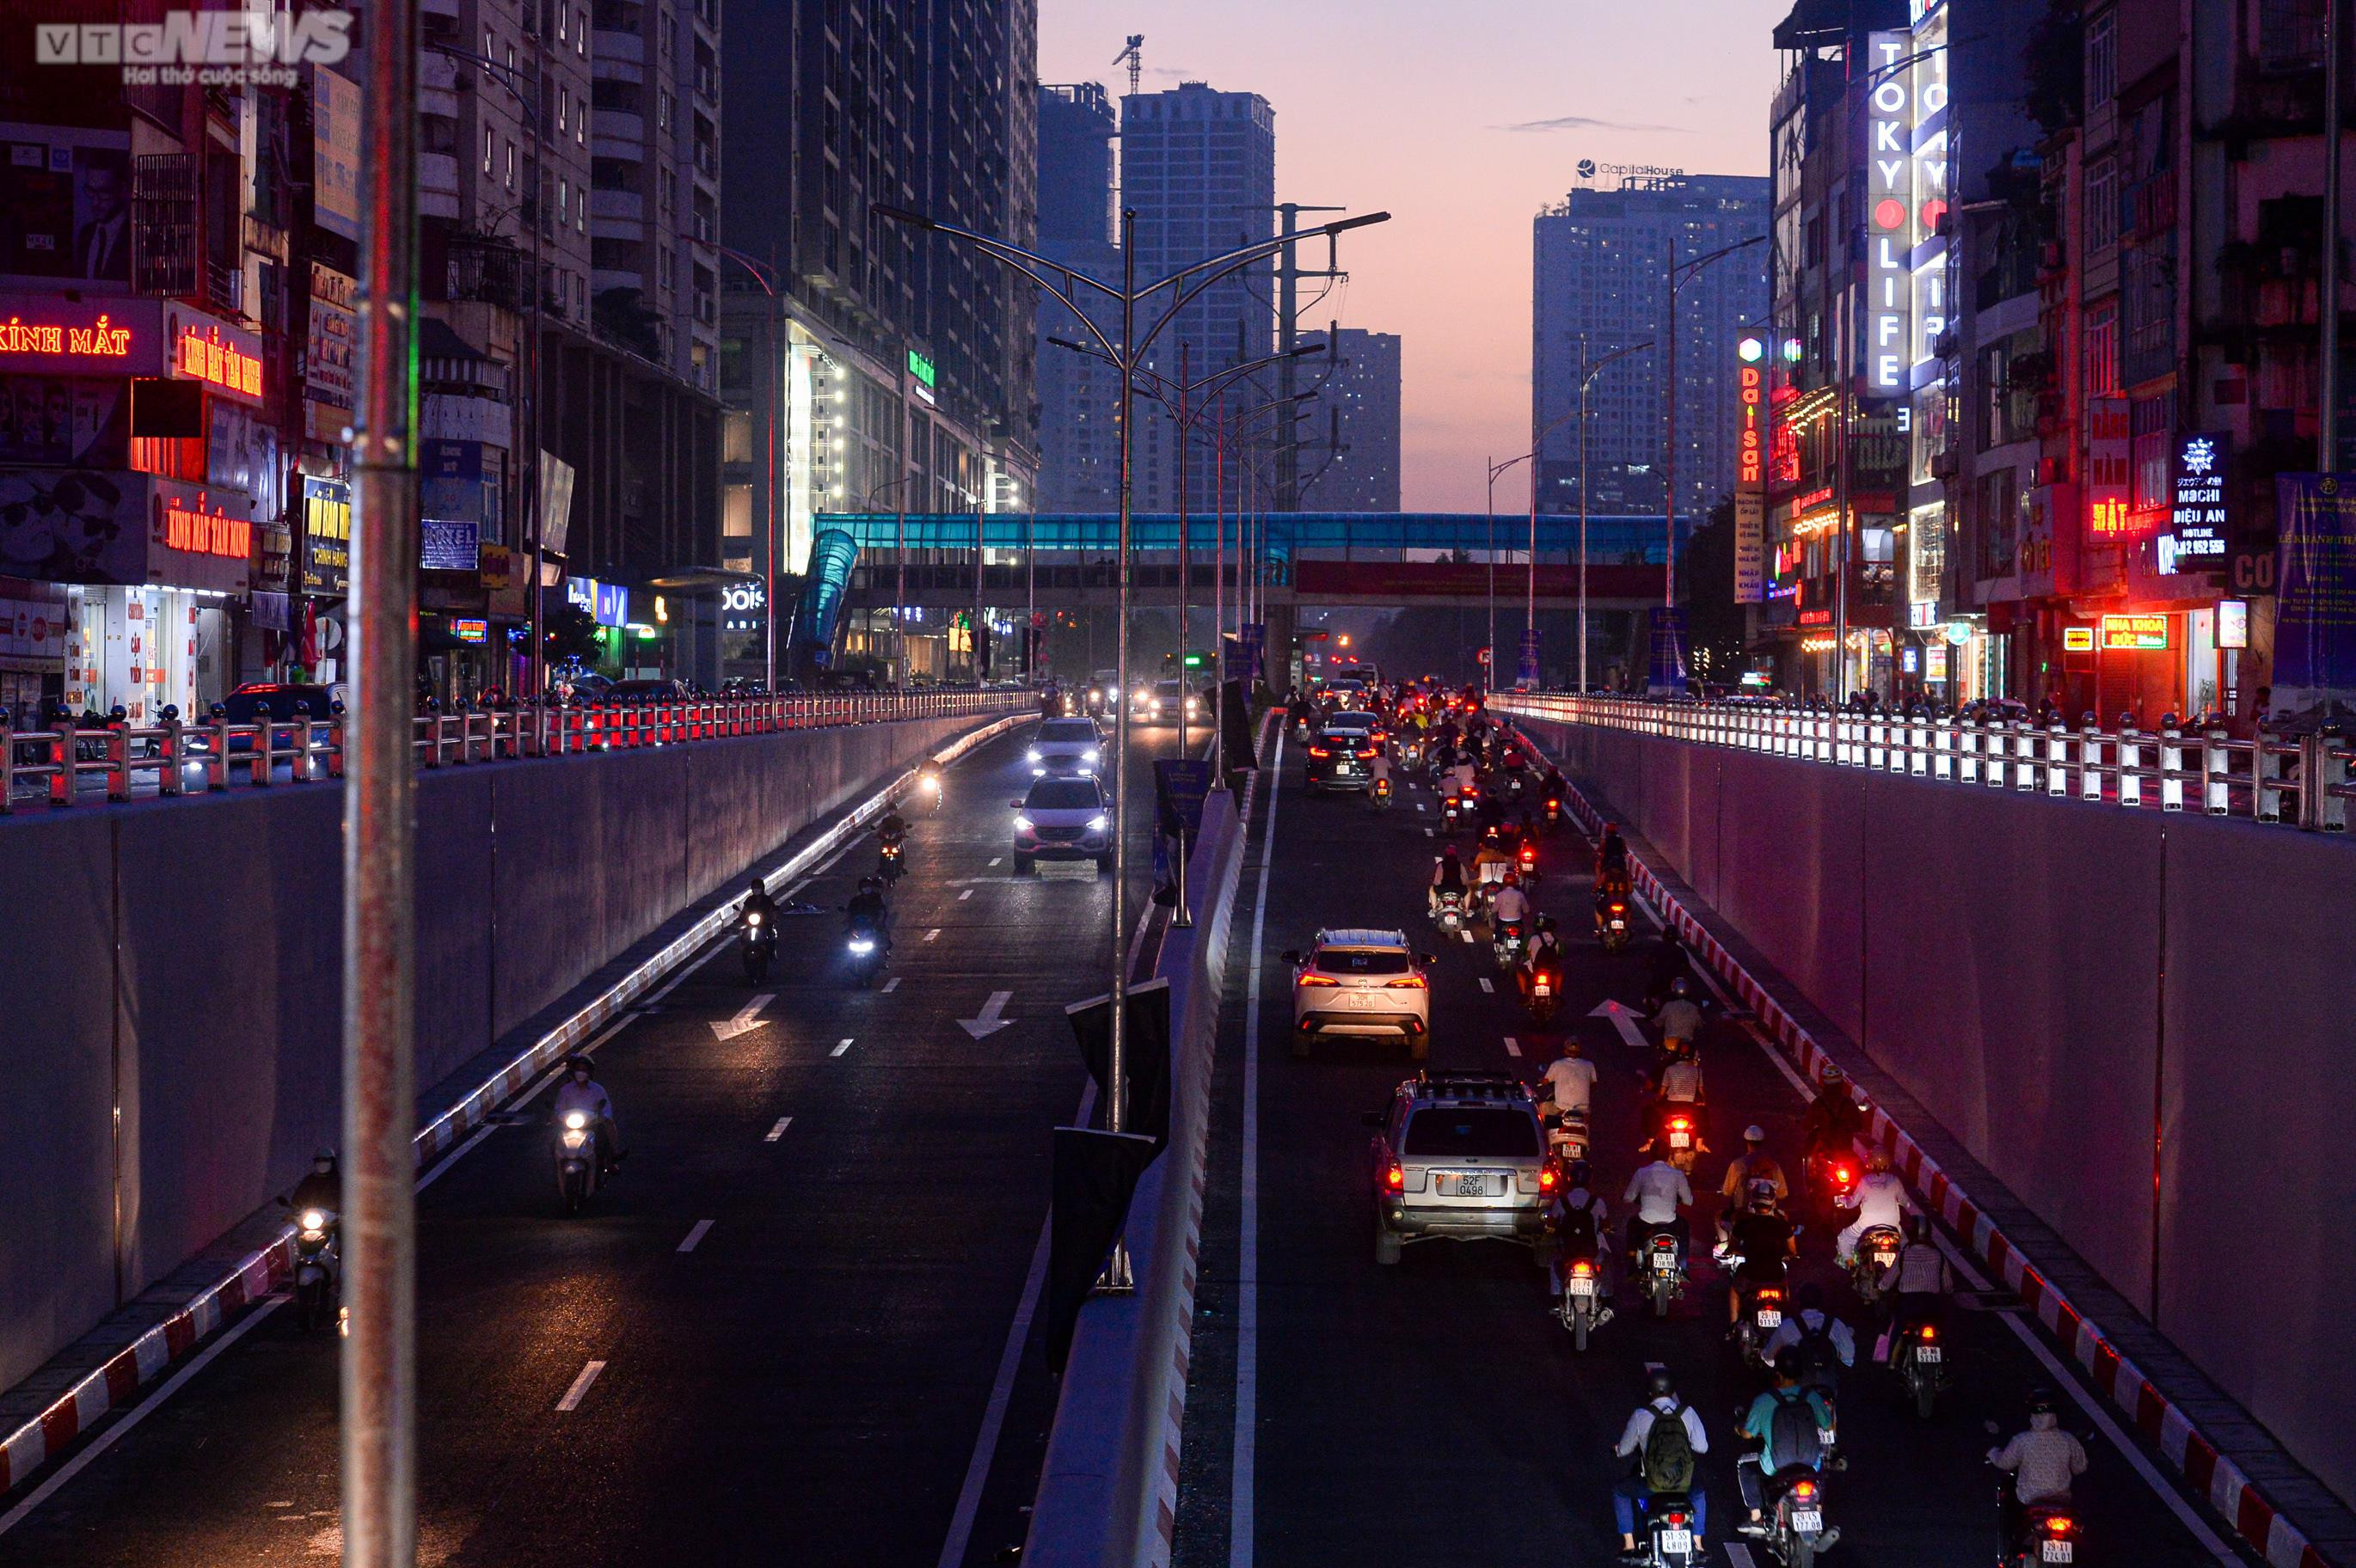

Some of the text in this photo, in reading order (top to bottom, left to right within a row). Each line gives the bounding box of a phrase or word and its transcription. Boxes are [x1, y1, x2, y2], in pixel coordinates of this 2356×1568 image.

[1879, 238, 1899, 387] LIFE
[70, 315, 130, 355] MẮT
[1742, 368, 1760, 482] Daisan
[2178, 489, 2220, 503] MOCHI
[2206, 509, 2225, 523] AN
[2105, 618, 2163, 632] NHA KHOA
[1463, 1176, 1481, 1185] 52F
[1460, 1185, 1483, 1195] 0498
